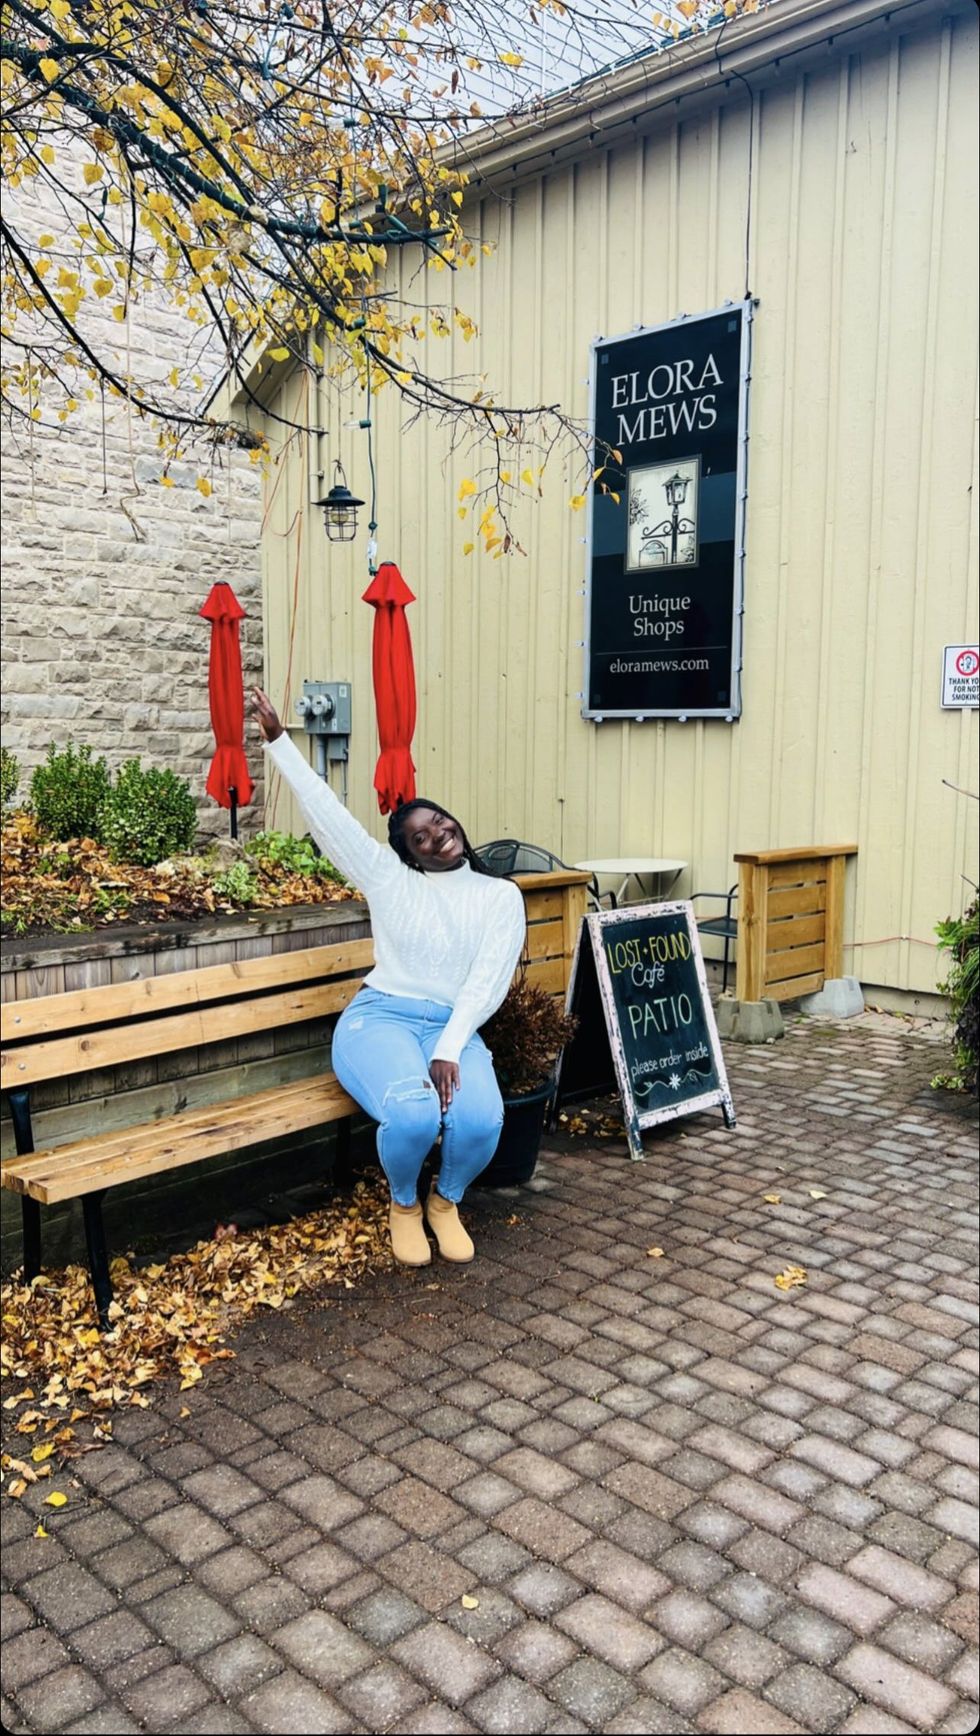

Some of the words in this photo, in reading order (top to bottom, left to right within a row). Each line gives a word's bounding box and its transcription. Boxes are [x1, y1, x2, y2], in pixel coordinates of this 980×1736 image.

[610, 353, 724, 409] ELORA
[616, 394, 718, 447] MEWS
[628, 594, 691, 617] Unique
[633, 617, 685, 641] Shops
[609, 658, 710, 673] eloramews.com
[949, 677, 970, 685] THANK
[971, 677, 979, 685] YO
[954, 686, 966, 694] FOR
[631, 961, 665, 988] Café
[628, 993, 692, 1039] PATIO
[630, 1057, 658, 1082] please
[659, 1049, 682, 1069] order
[685, 1041, 709, 1062] inside
